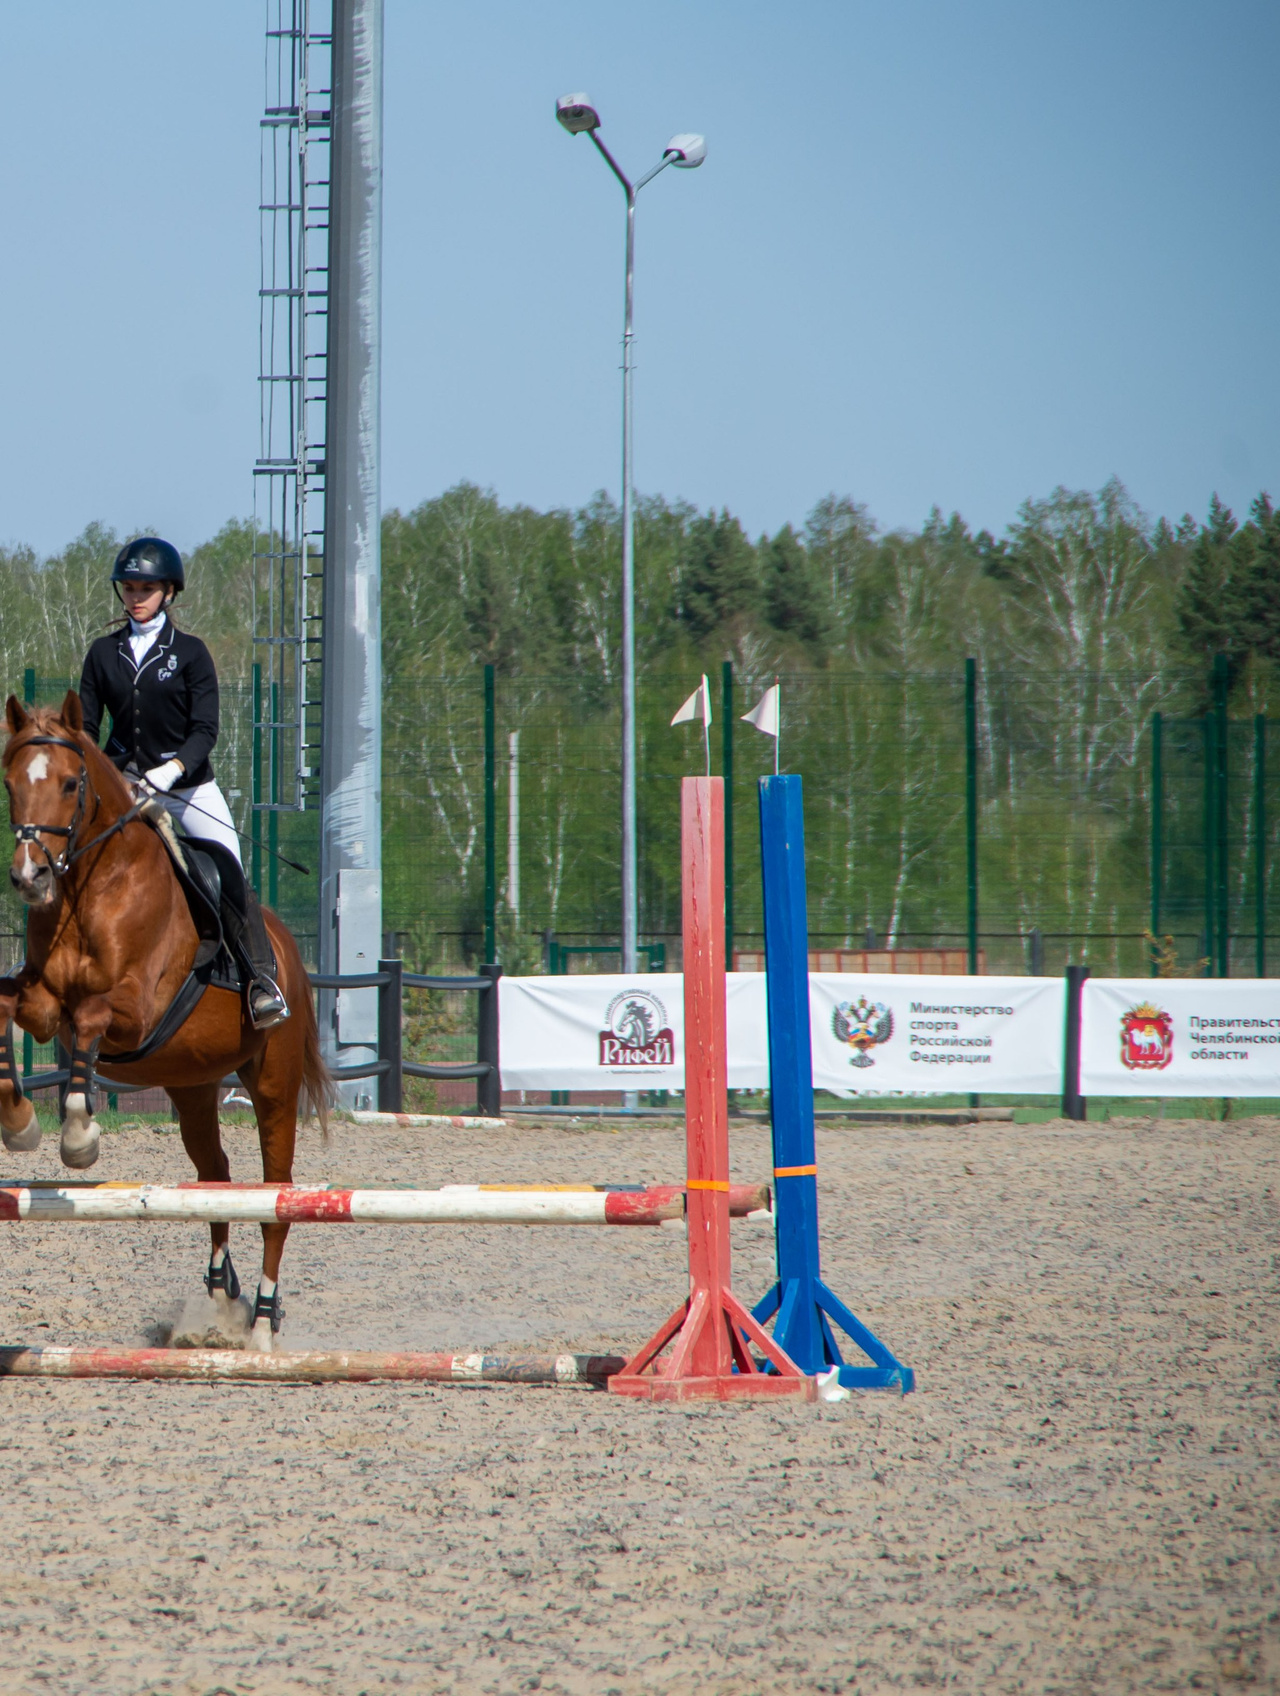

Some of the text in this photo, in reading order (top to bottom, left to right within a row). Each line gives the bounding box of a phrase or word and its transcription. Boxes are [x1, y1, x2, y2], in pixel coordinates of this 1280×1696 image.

[910, 1002, 1014, 1017] Министерство
[910, 1021, 959, 1032] спорта
[910, 1034, 992, 1047] Российской
[910, 1051, 991, 1066] Федерации
[1190, 1048, 1249, 1060] области
